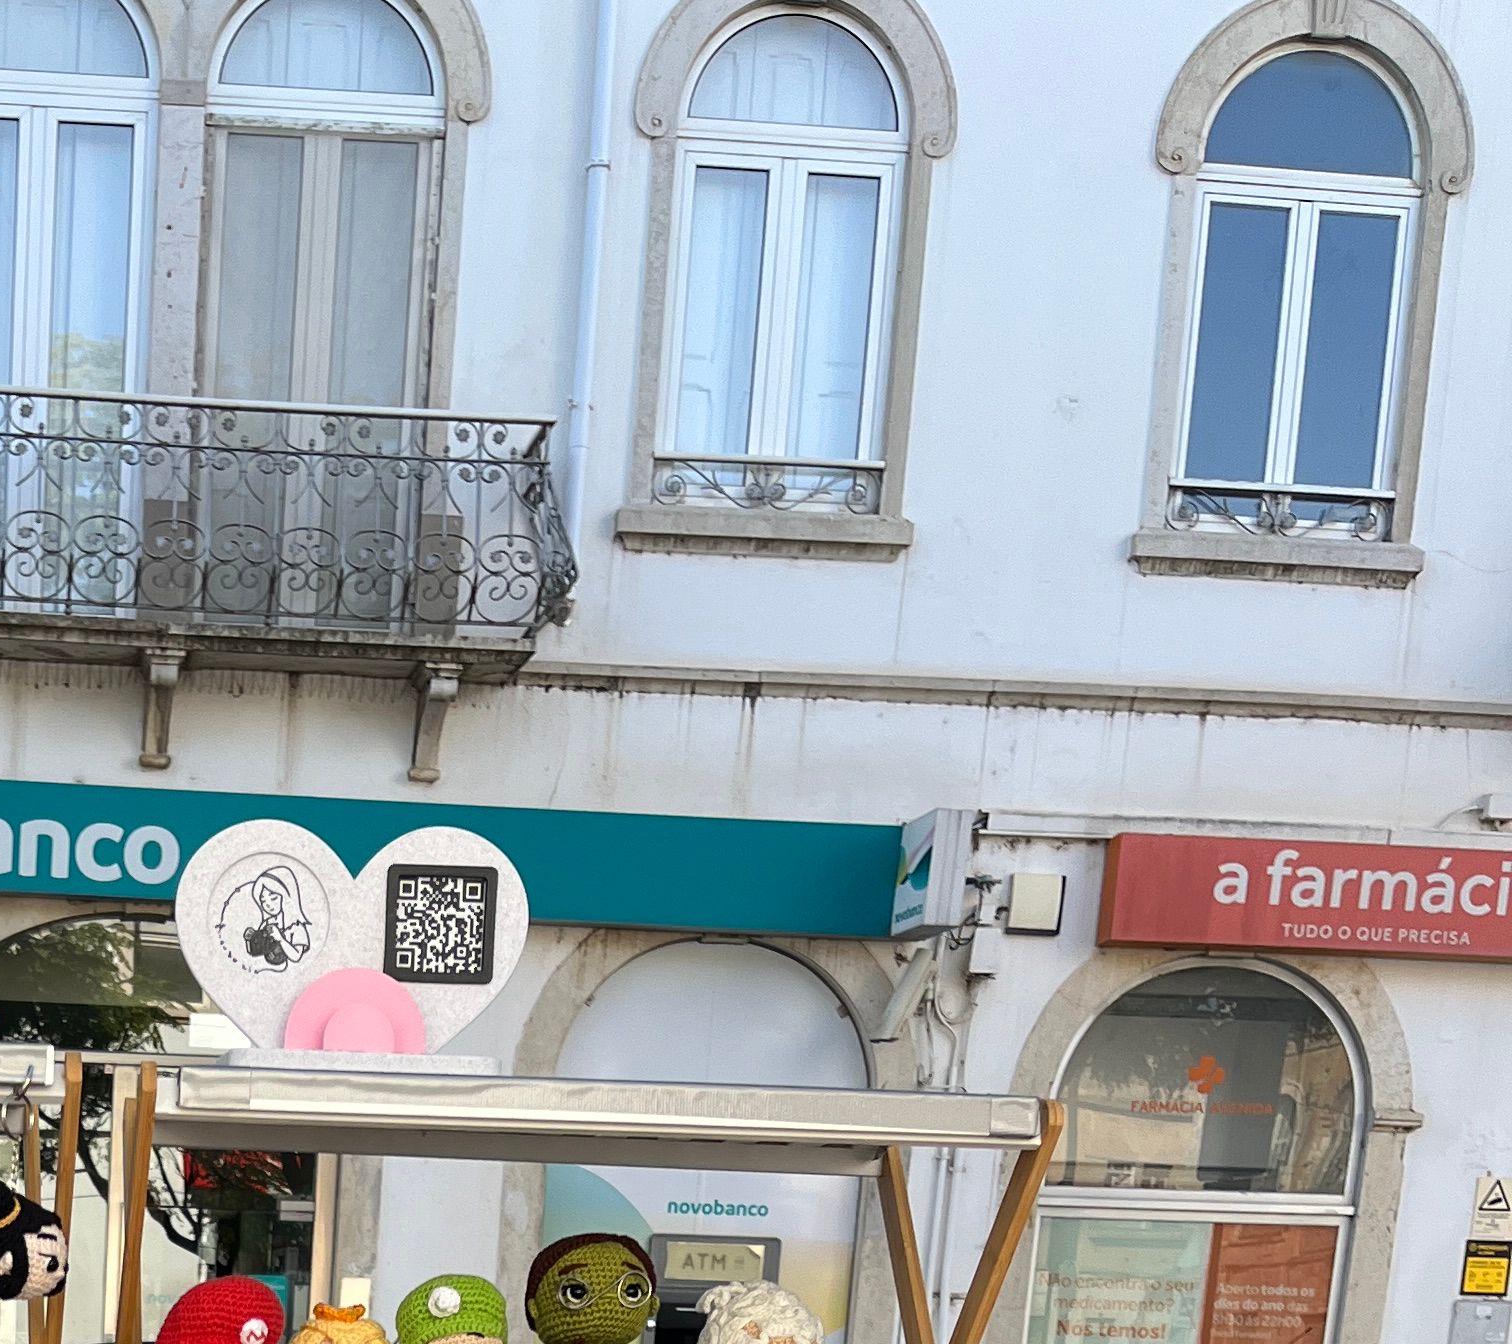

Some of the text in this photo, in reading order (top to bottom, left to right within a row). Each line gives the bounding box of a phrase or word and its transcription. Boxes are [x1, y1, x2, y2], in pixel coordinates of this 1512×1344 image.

[1212, 862, 1249, 905] a
[1281, 922, 1471, 946] TUDO O QUE PRECISA
[667, 1199, 769, 1217] novobanco
[682, 1252, 727, 1271] ATM
[1164, 1279, 1195, 1293] seu
[1099, 1321, 1167, 1340] temos!
